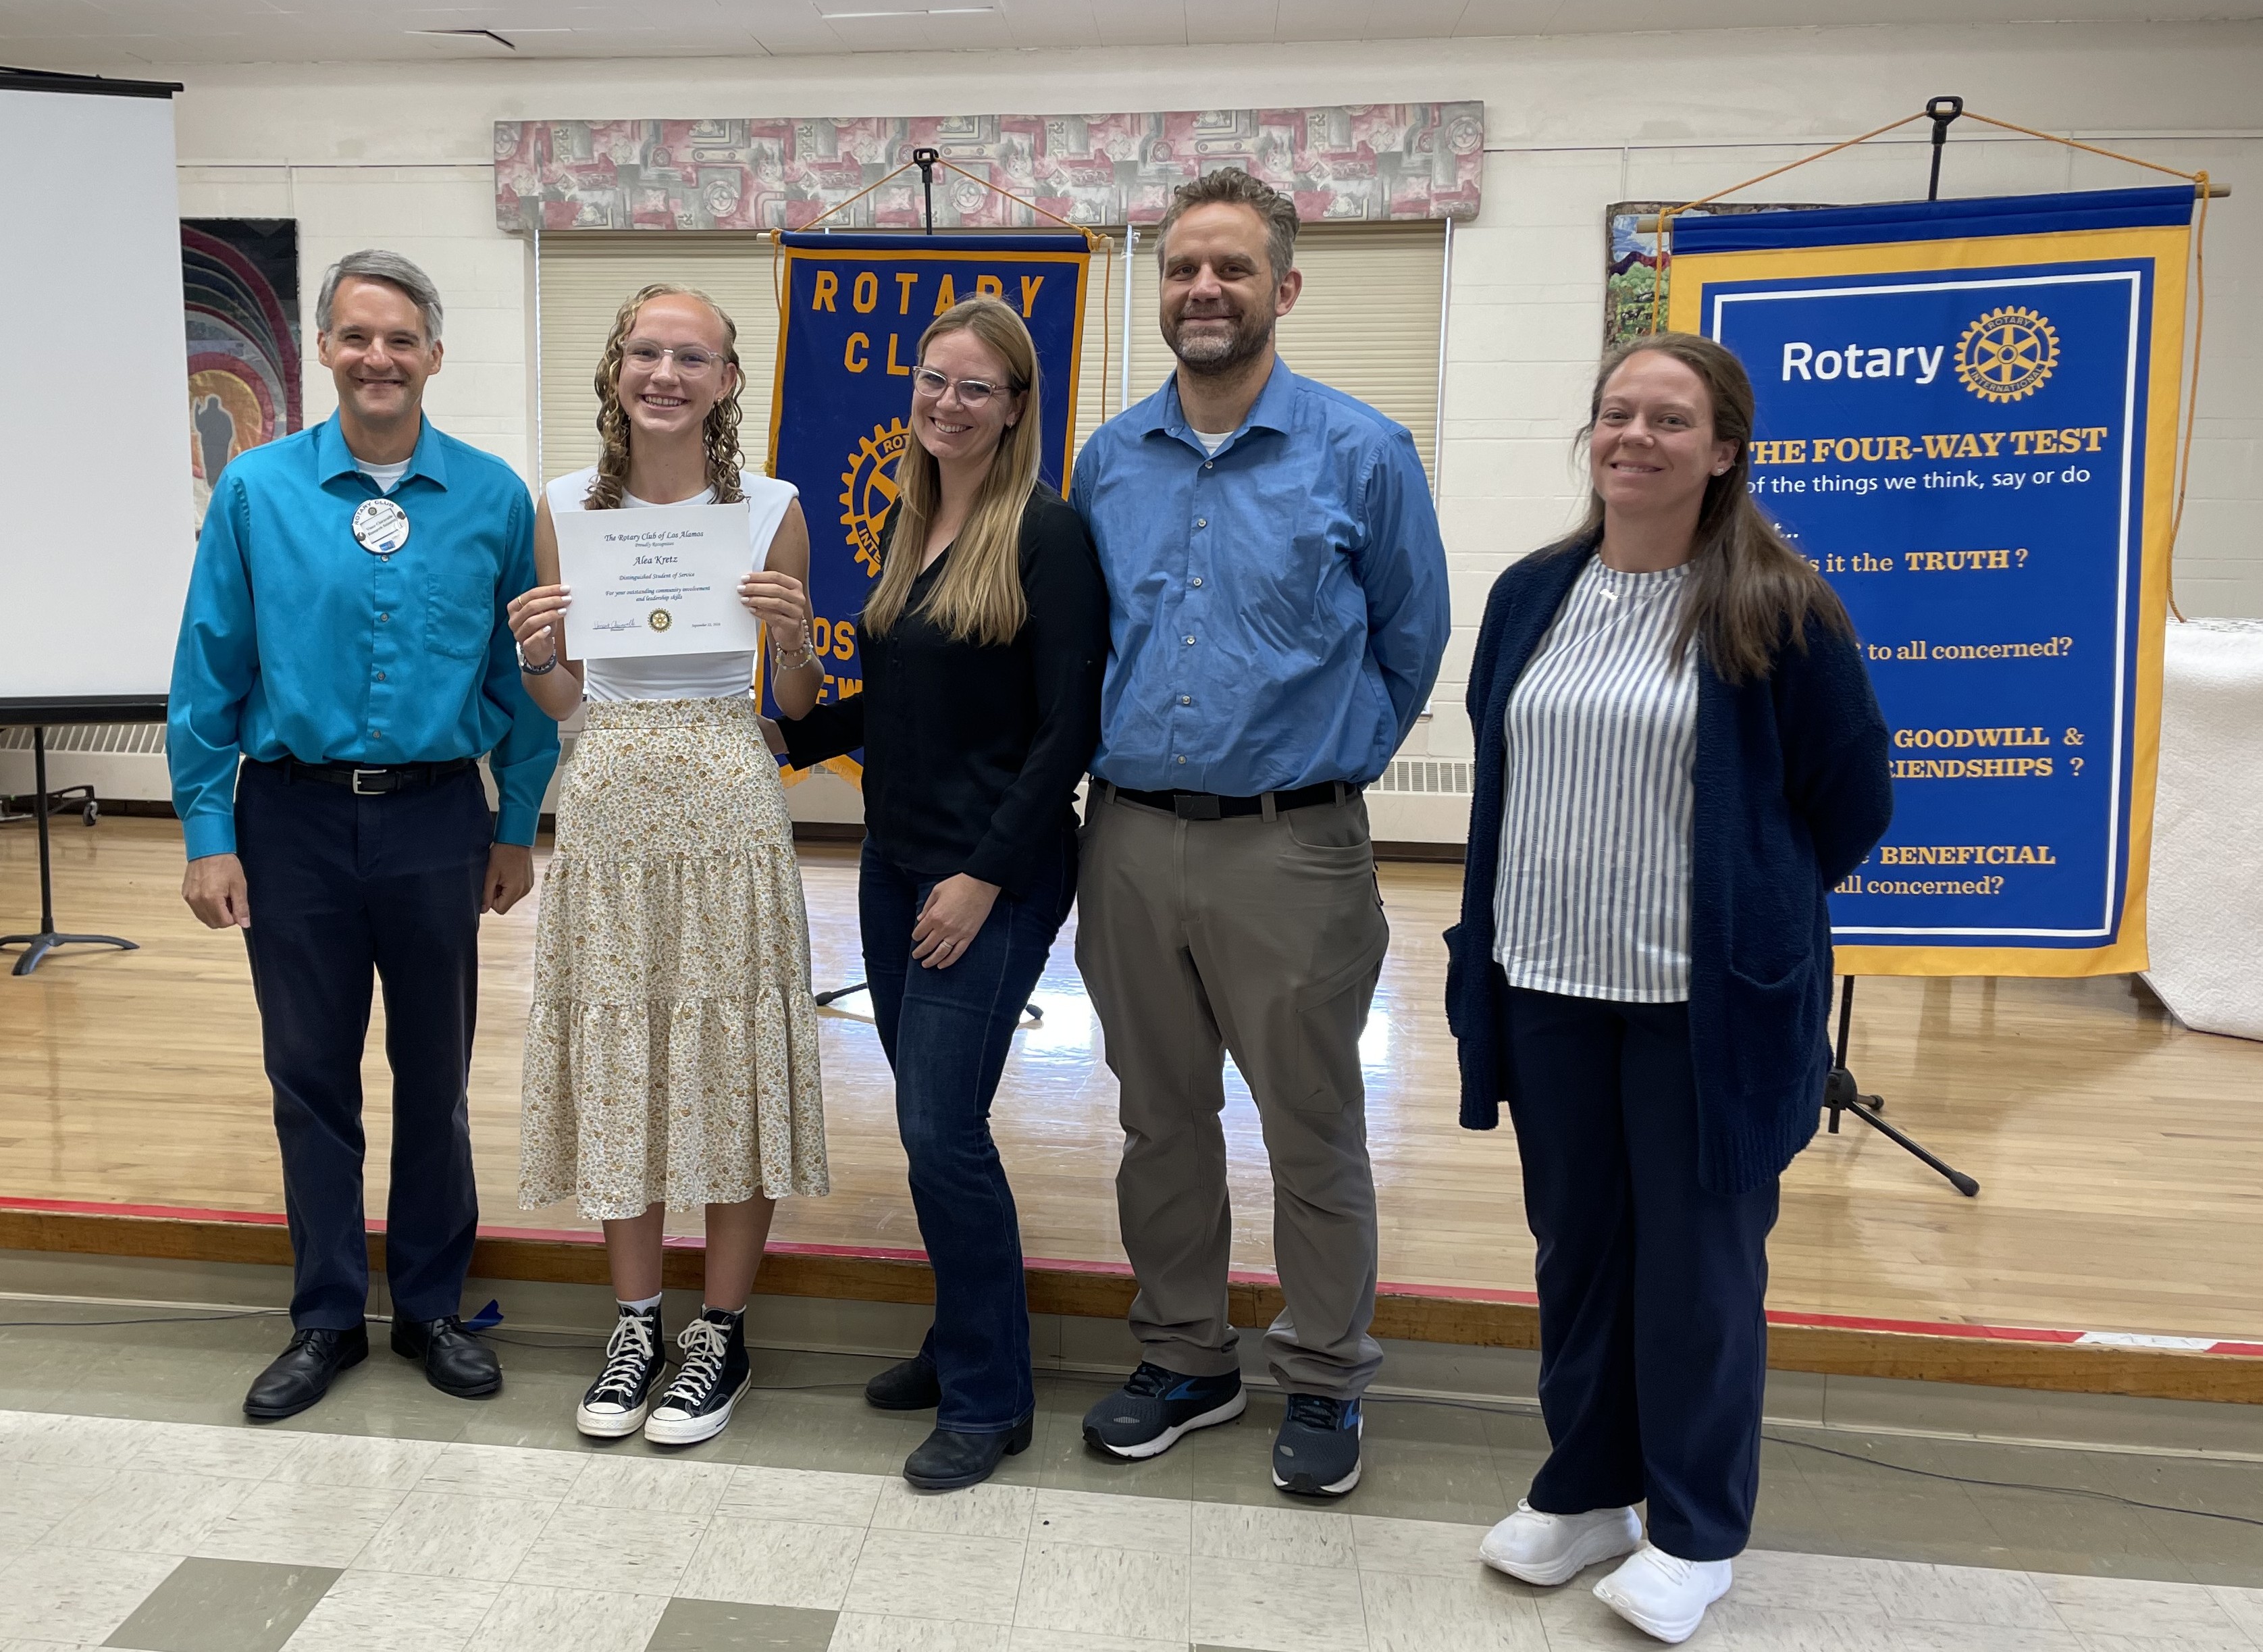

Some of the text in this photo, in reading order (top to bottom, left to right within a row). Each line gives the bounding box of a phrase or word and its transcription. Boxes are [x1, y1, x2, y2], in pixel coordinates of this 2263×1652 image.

[1987, 316, 2032, 330] ROTARY
[843, 332, 910, 376] CL
[1782, 342, 1945, 384] Rotary
[1971, 367, 2044, 393] INTERNATIONAL
[1812, 432, 2006, 463] FOUR-WAY
[2010, 427, 2108, 455] TEST
[1747, 465, 2091, 495] of the things we think, say or do
[354, 502, 371, 525] ROTARY
[374, 500, 394, 508] CLUB
[604, 530, 704, 542] The Rotary Club of Los Alamos
[633, 555, 679, 567] Alea Kretz
[1825, 552, 1846, 573] it
[1850, 552, 1894, 573] the
[1905, 549, 2010, 571] TRUTH
[2015, 548, 2029, 569] ?
[619, 573, 652, 582] Distinguished
[813, 616, 856, 661] OS
[1867, 644, 1892, 661] to
[1896, 640, 1927, 660] all
[1931, 636, 2073, 660] concerned?
[1894, 727, 2085, 748] GOODWILL &
[1889, 756, 2085, 779] IENDSHIPS ?
[1879, 845, 2056, 865] BENEFICIAL
[1833, 875, 2005, 895] all concerned?
